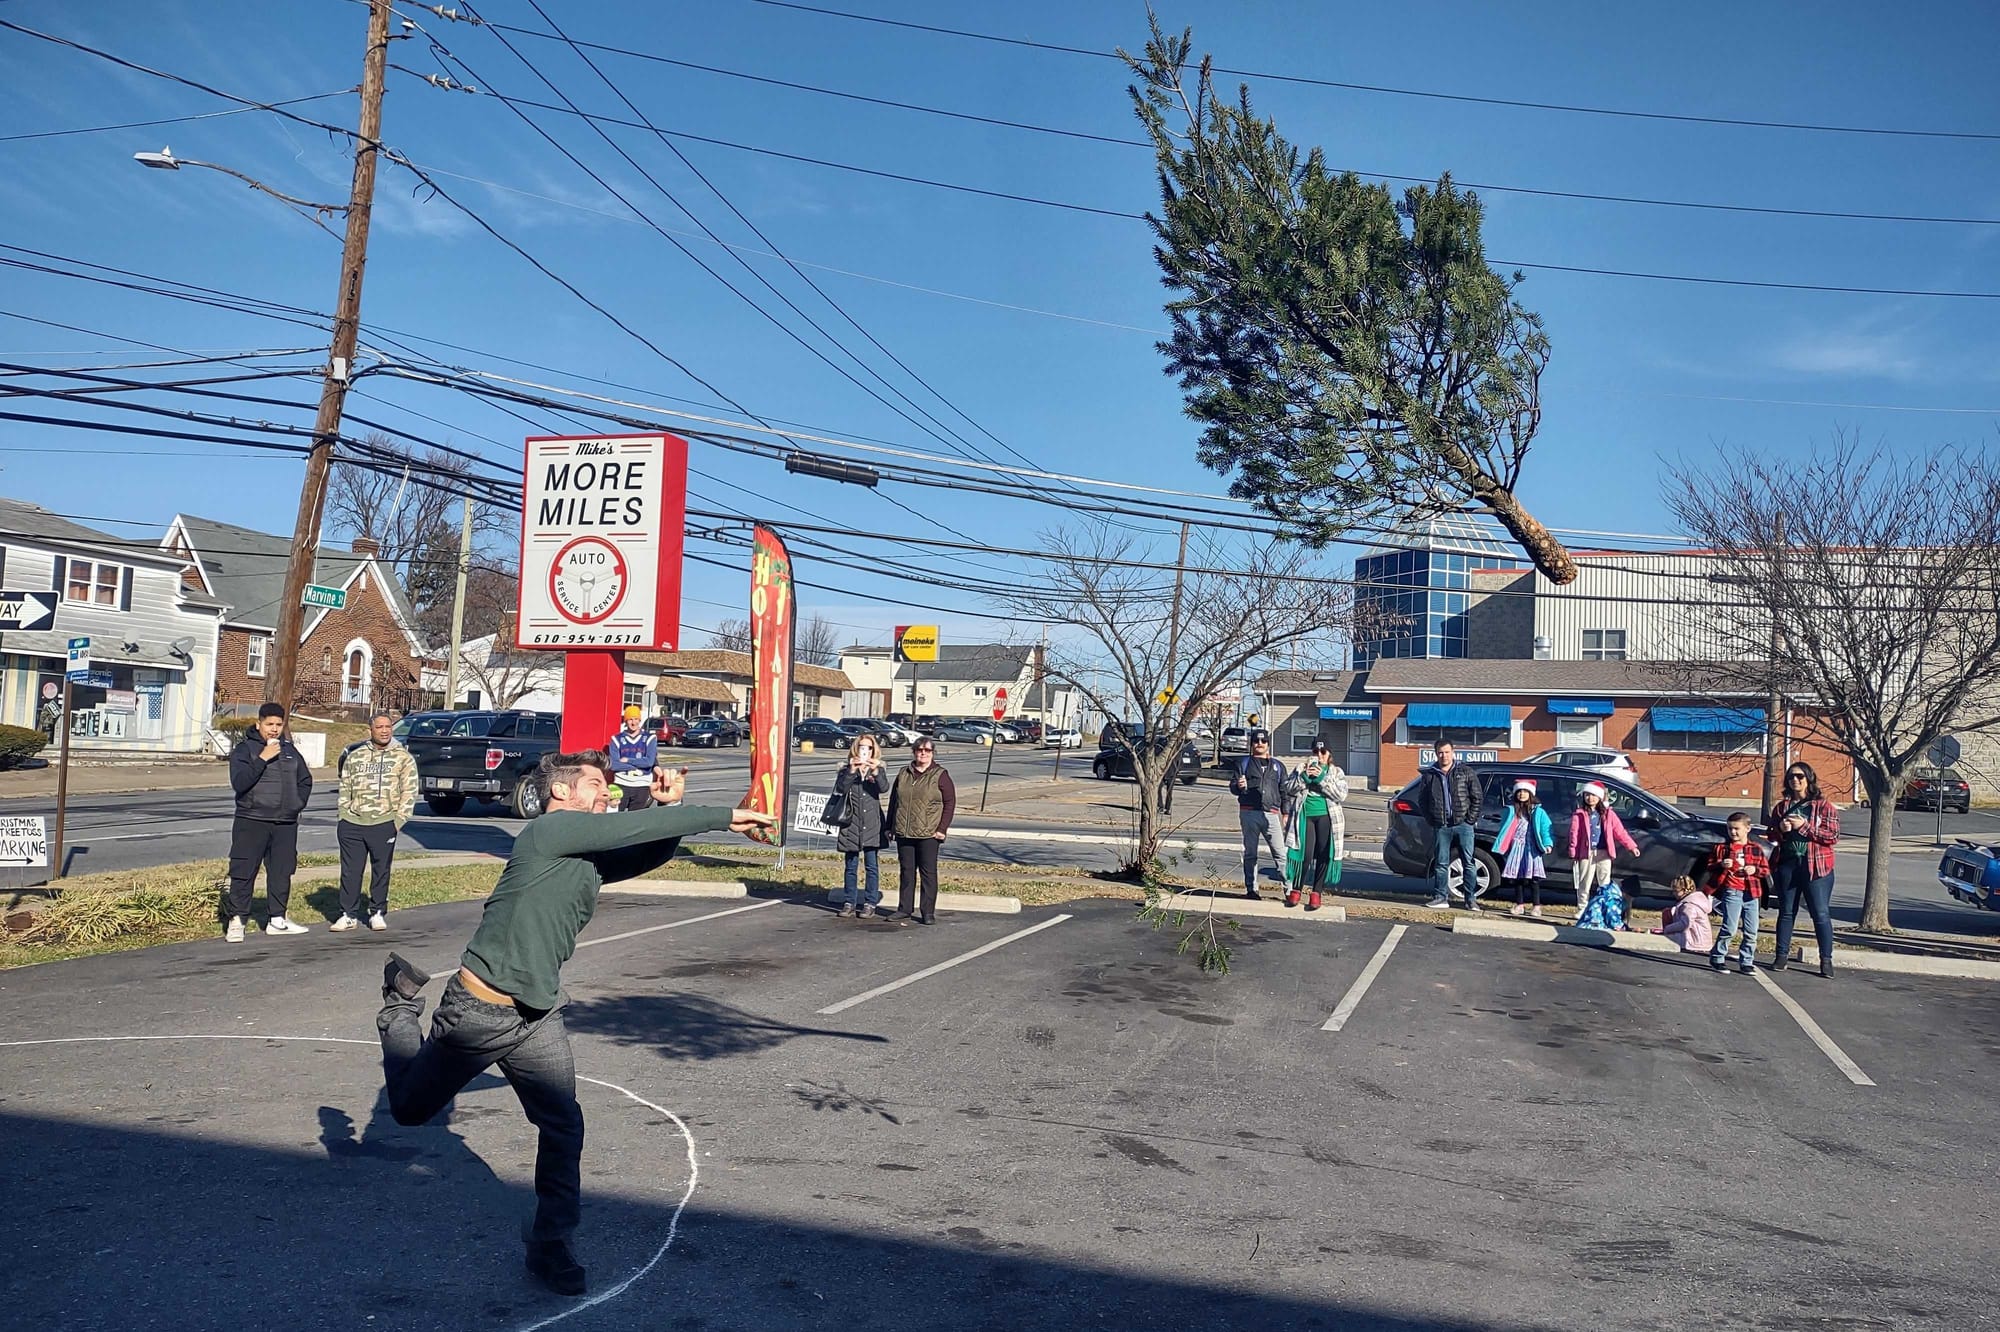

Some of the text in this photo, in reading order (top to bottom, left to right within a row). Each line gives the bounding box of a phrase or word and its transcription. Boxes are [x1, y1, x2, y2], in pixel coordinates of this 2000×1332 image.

[575, 442, 614, 455] Mike's
[544, 462, 646, 491] MORE
[538, 496, 643, 526] MILES
[570, 553, 606, 565] AUTO
[557, 581, 580, 613] SERVICE
[593, 584, 617, 613] CENTER
[0, 603, 23, 618] AY
[534, 634, 641, 644] 610-954-0510
[1422, 750, 1438, 763] STA
[1466, 752, 1495, 762] SALON
[800, 794, 829, 804] CHRIST
[0, 818, 36, 828] RISTMAS
[0, 839, 46, 857] ARKING
